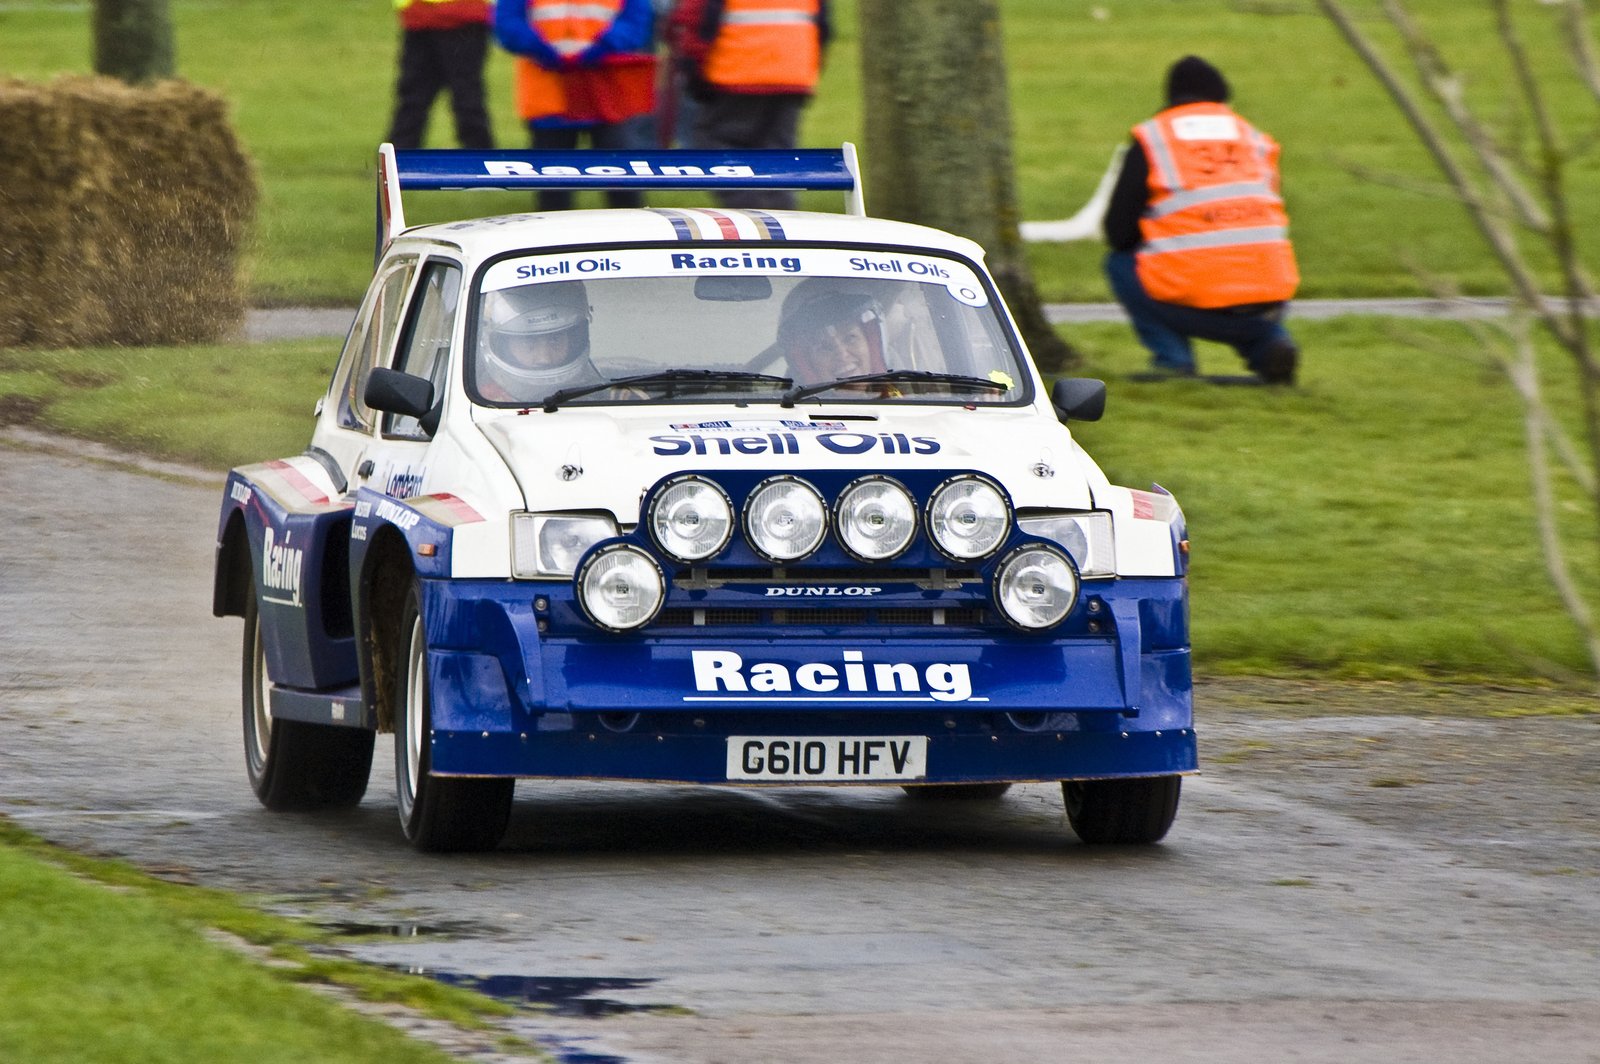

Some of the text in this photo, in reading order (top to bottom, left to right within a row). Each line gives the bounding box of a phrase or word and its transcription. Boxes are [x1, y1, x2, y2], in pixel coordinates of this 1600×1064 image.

[484, 161, 755, 178] Racing
[516, 258, 622, 279] Shell Oils
[671, 253, 802, 272] Racing
[849, 257, 950, 279] Shell Oils
[649, 433, 941, 456] Shell Oils
[375, 500, 419, 530] DUNLOP
[263, 527, 303, 606] Racing
[765, 587, 882, 597] DUNLOP
[691, 650, 973, 702] Racing
[742, 740, 911, 775] G610 HFV
